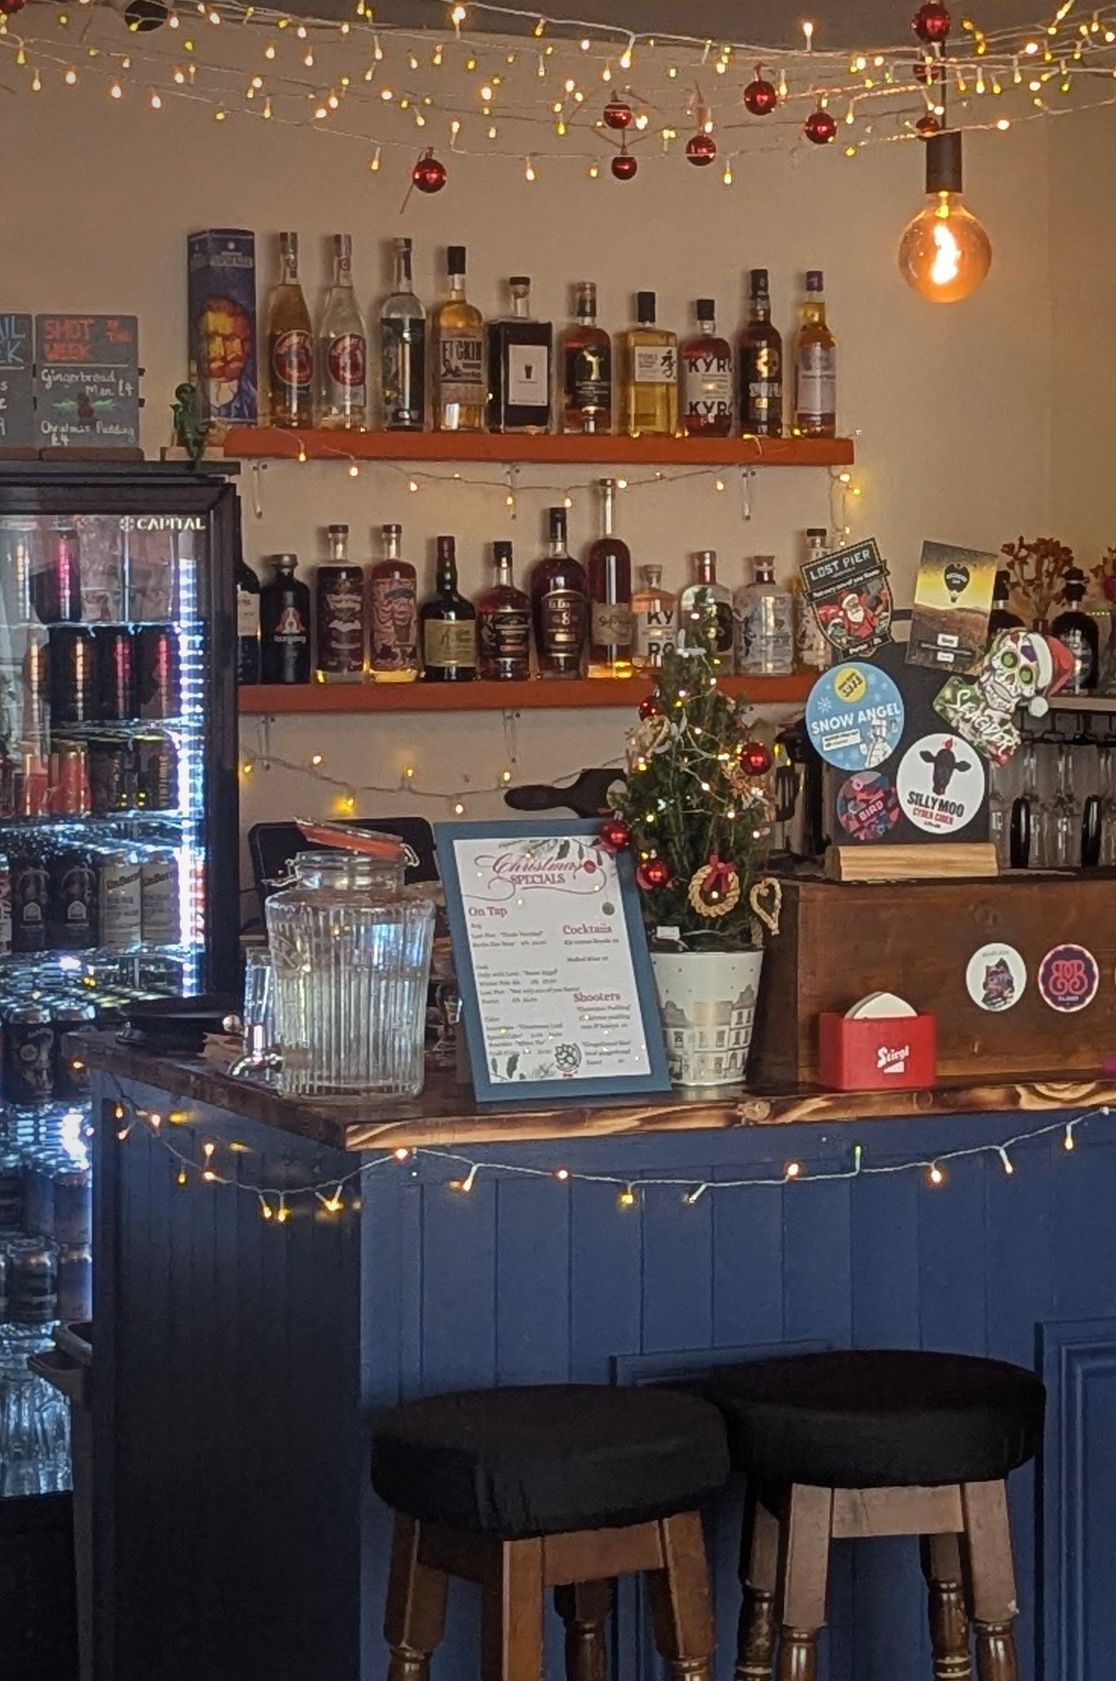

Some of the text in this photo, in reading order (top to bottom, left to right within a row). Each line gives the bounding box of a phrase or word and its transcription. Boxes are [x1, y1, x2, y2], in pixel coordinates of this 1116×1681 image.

[41, 368, 116, 390] Gingerbread
[136, 517, 206, 531] CAPITAL
[809, 561, 840, 580] LOST
[842, 549, 871, 568] PIER
[647, 610, 674, 625] KY
[811, 702, 902, 735] SNOW ANGEL
[858, 801, 885, 821] BIRD
[510, 873, 566, 885] SPECIALS
[468, 906, 508, 919] On Tap
[563, 922, 613, 935] Cocktails
[573, 992, 621, 1003] Shooters
